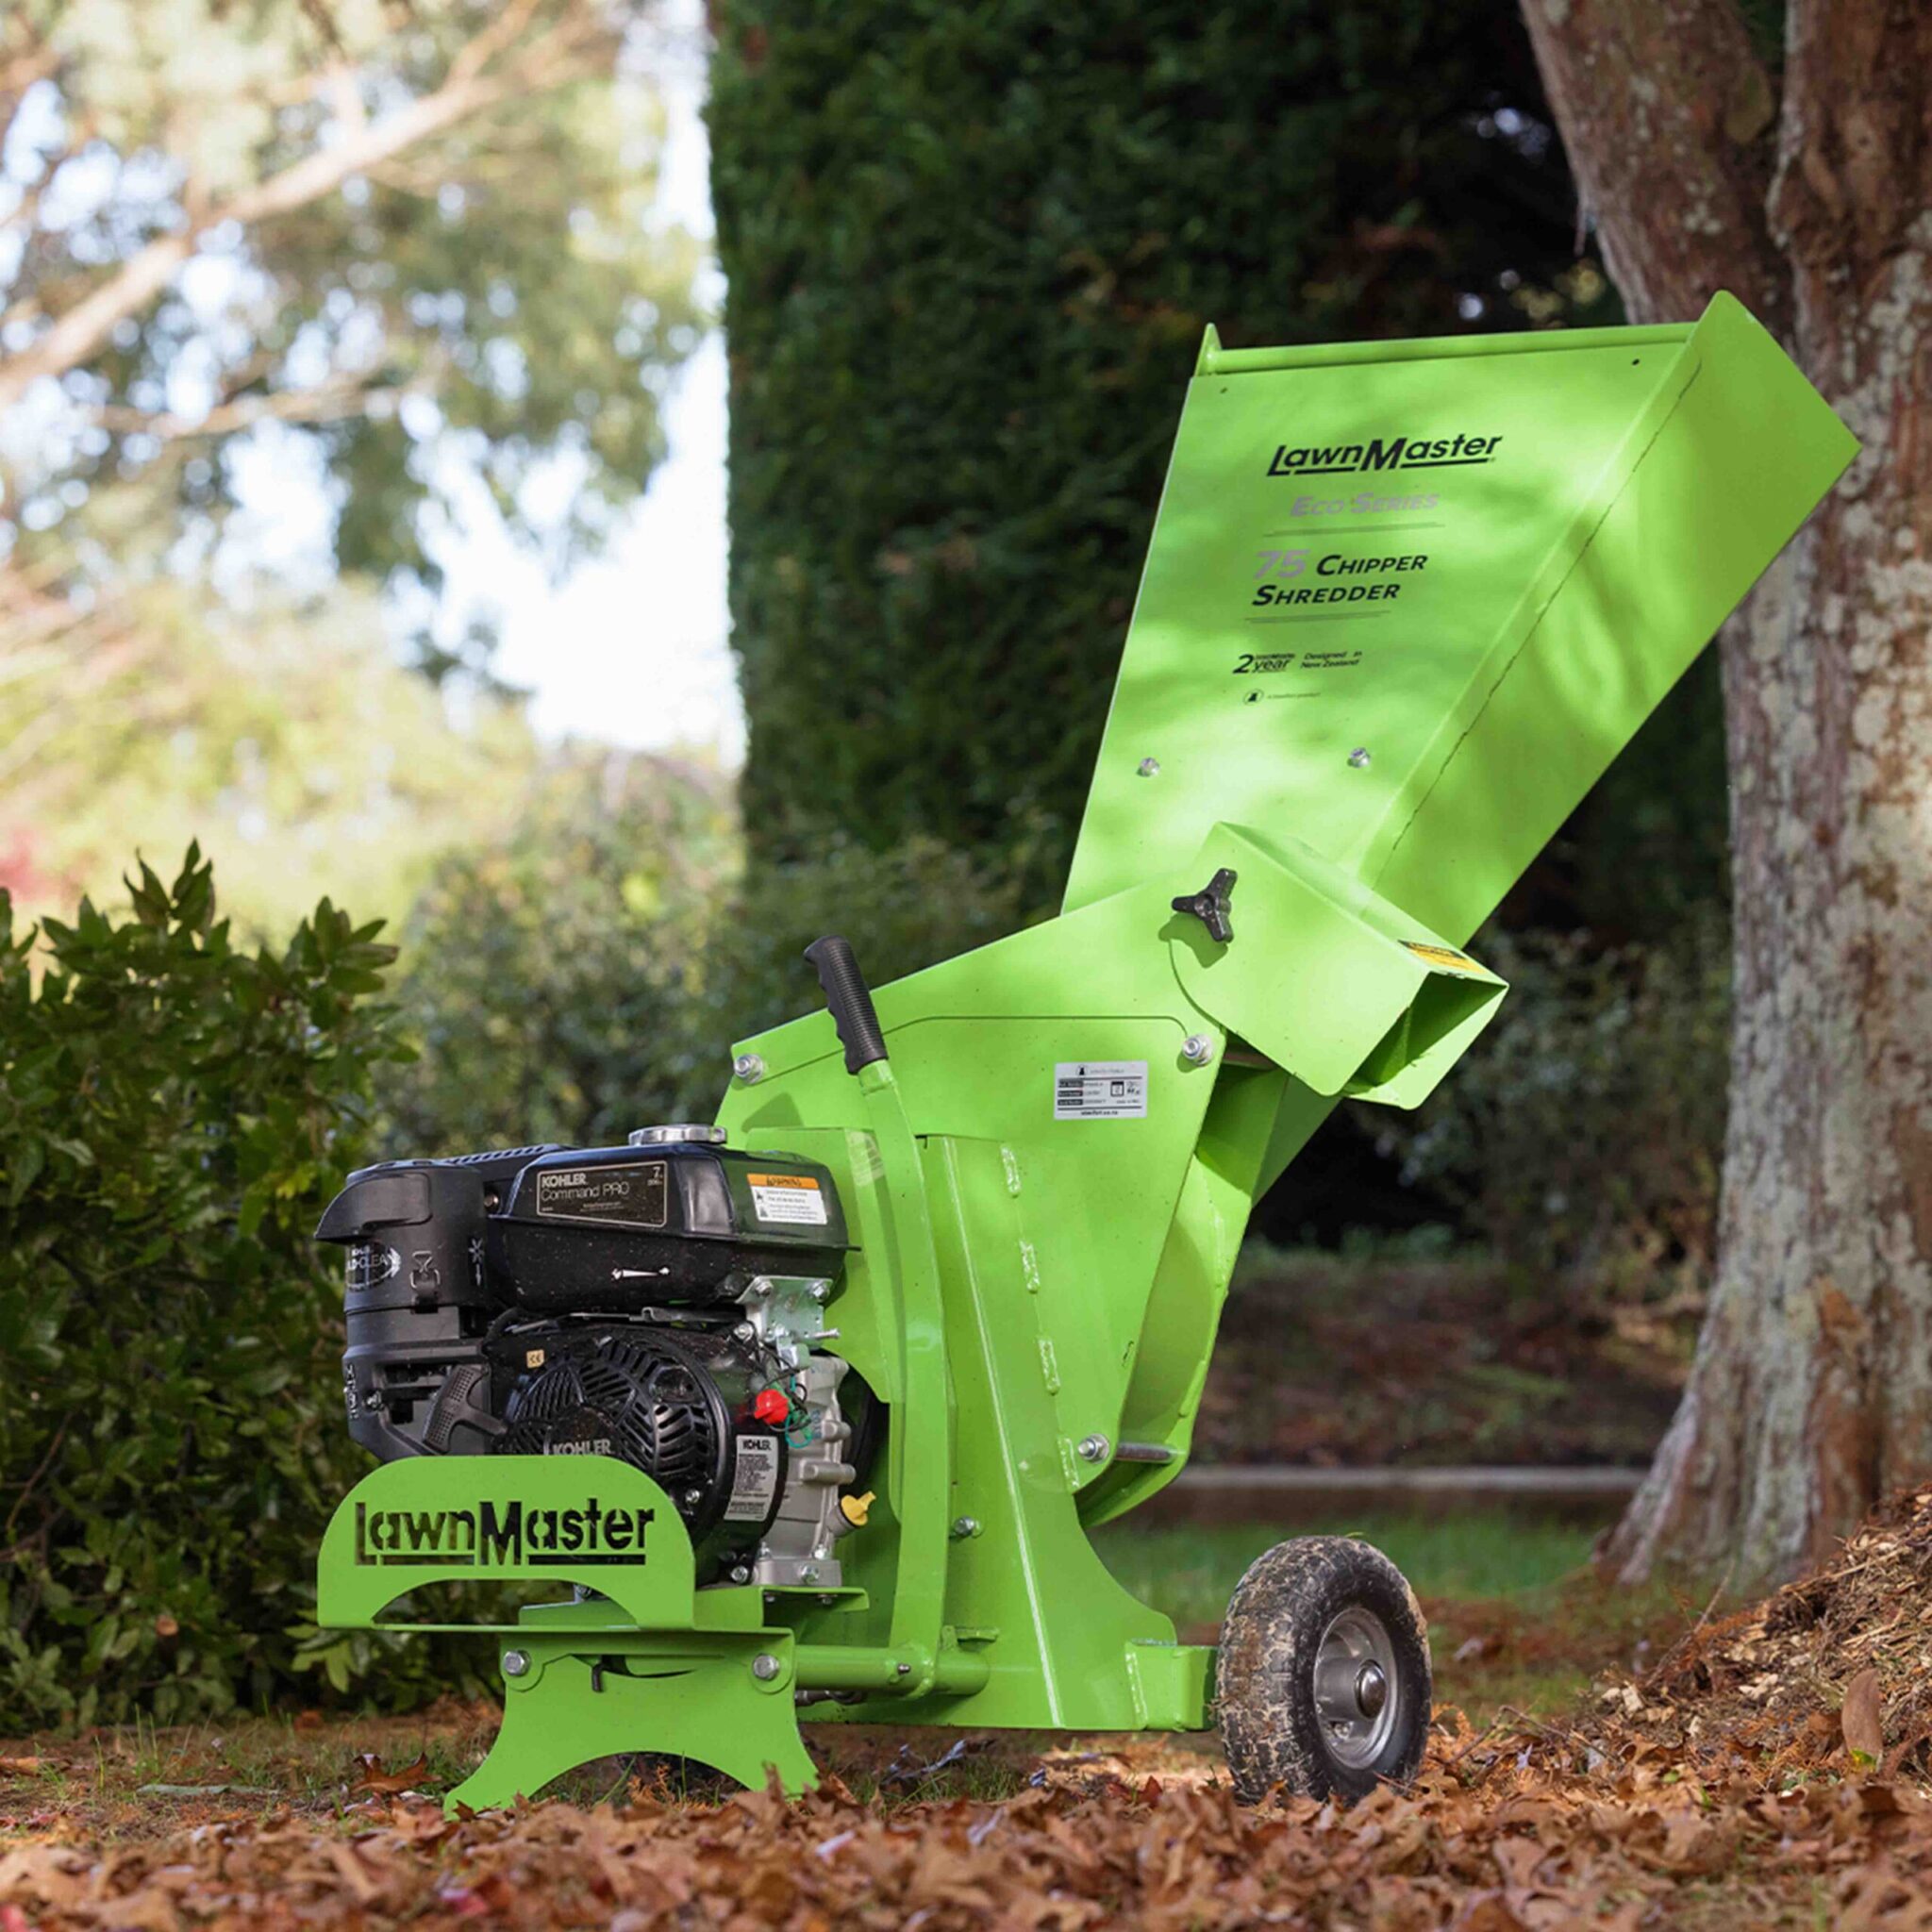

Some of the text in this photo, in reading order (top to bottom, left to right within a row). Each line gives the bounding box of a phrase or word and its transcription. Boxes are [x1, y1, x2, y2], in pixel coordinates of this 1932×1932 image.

[1266, 433, 1503, 476] LawnMaster
[1254, 549, 1309, 579] 75
[1232, 654, 1255, 675] 2
[541, 1173, 587, 1189] KOHLER
[541, 1187, 600, 1202] Command
[602, 1181, 630, 1196] PRO
[553, 1439, 611, 1456] KOHLER
[743, 1440, 771, 1450] KOHLER
[355, 1498, 655, 1566] LawnMaster
